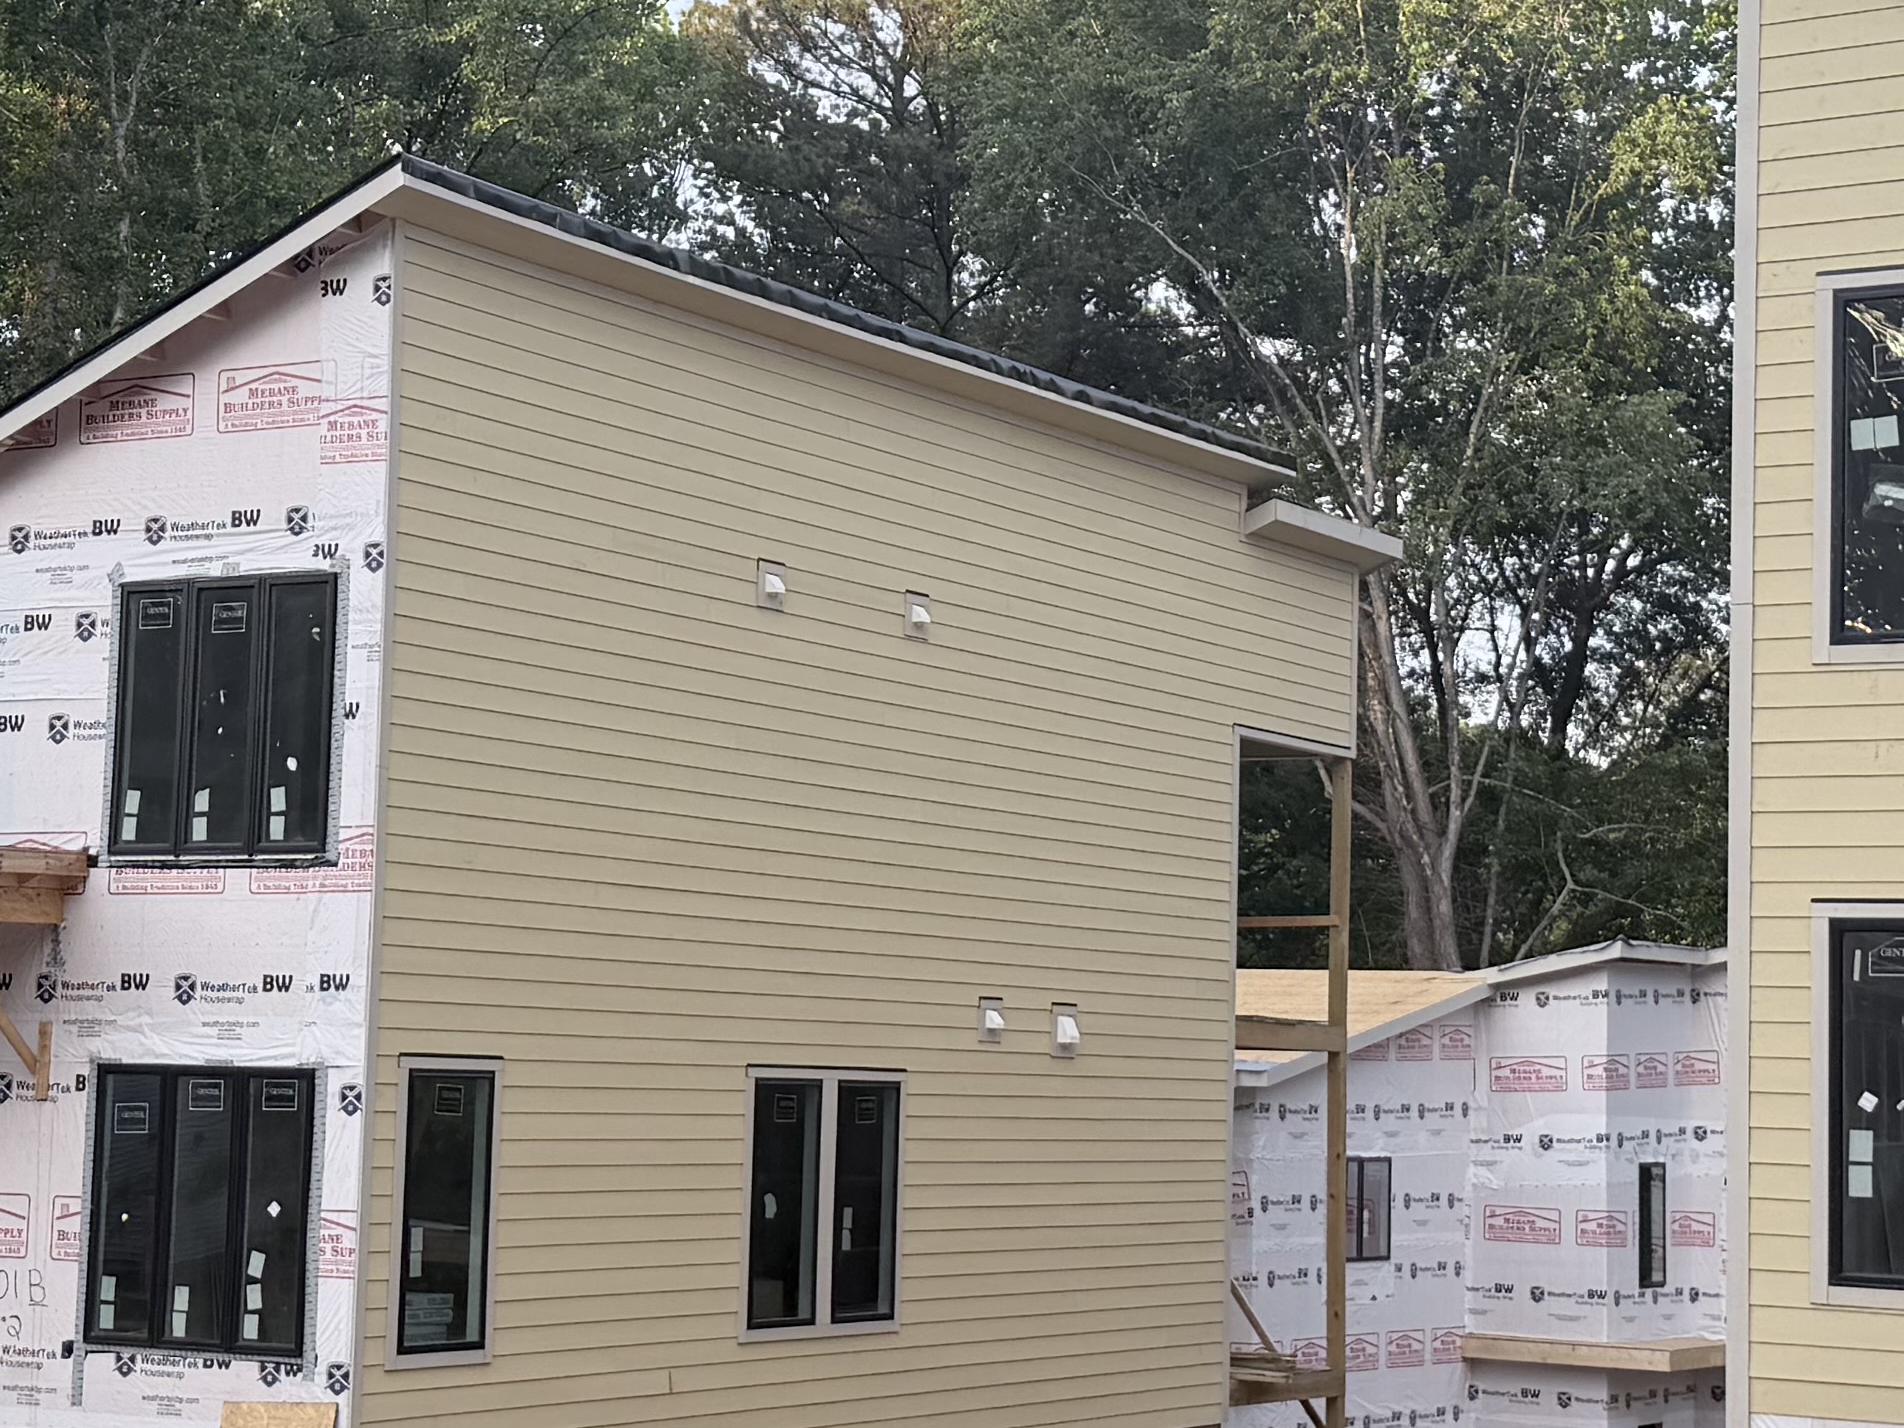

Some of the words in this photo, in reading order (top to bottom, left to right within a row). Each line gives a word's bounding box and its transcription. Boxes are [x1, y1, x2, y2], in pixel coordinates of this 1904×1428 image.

[248, 385, 299, 400] MEBANE
[109, 397, 158, 412] MEBANE
[224, 398, 283, 414] BUILDERS
[86, 410, 142, 426] BUILDERS
[146, 406, 190, 422] SUPPLY
[327, 418, 379, 432] MEBANE
[33, 529, 89, 541] WeatherTek
[92, 518, 121, 537] BW
[170, 521, 228, 533] WeatherTek
[230, 508, 262, 528] BW
[23, 613, 52, 633] BW
[61, 979, 117, 993] WeatherTek
[120, 973, 150, 992] BW
[200, 980, 259, 994] WeatherTek
[262, 974, 293, 993] BW
[319, 973, 350, 992] BW
[140, 1353, 199, 1369] WeatherTek
